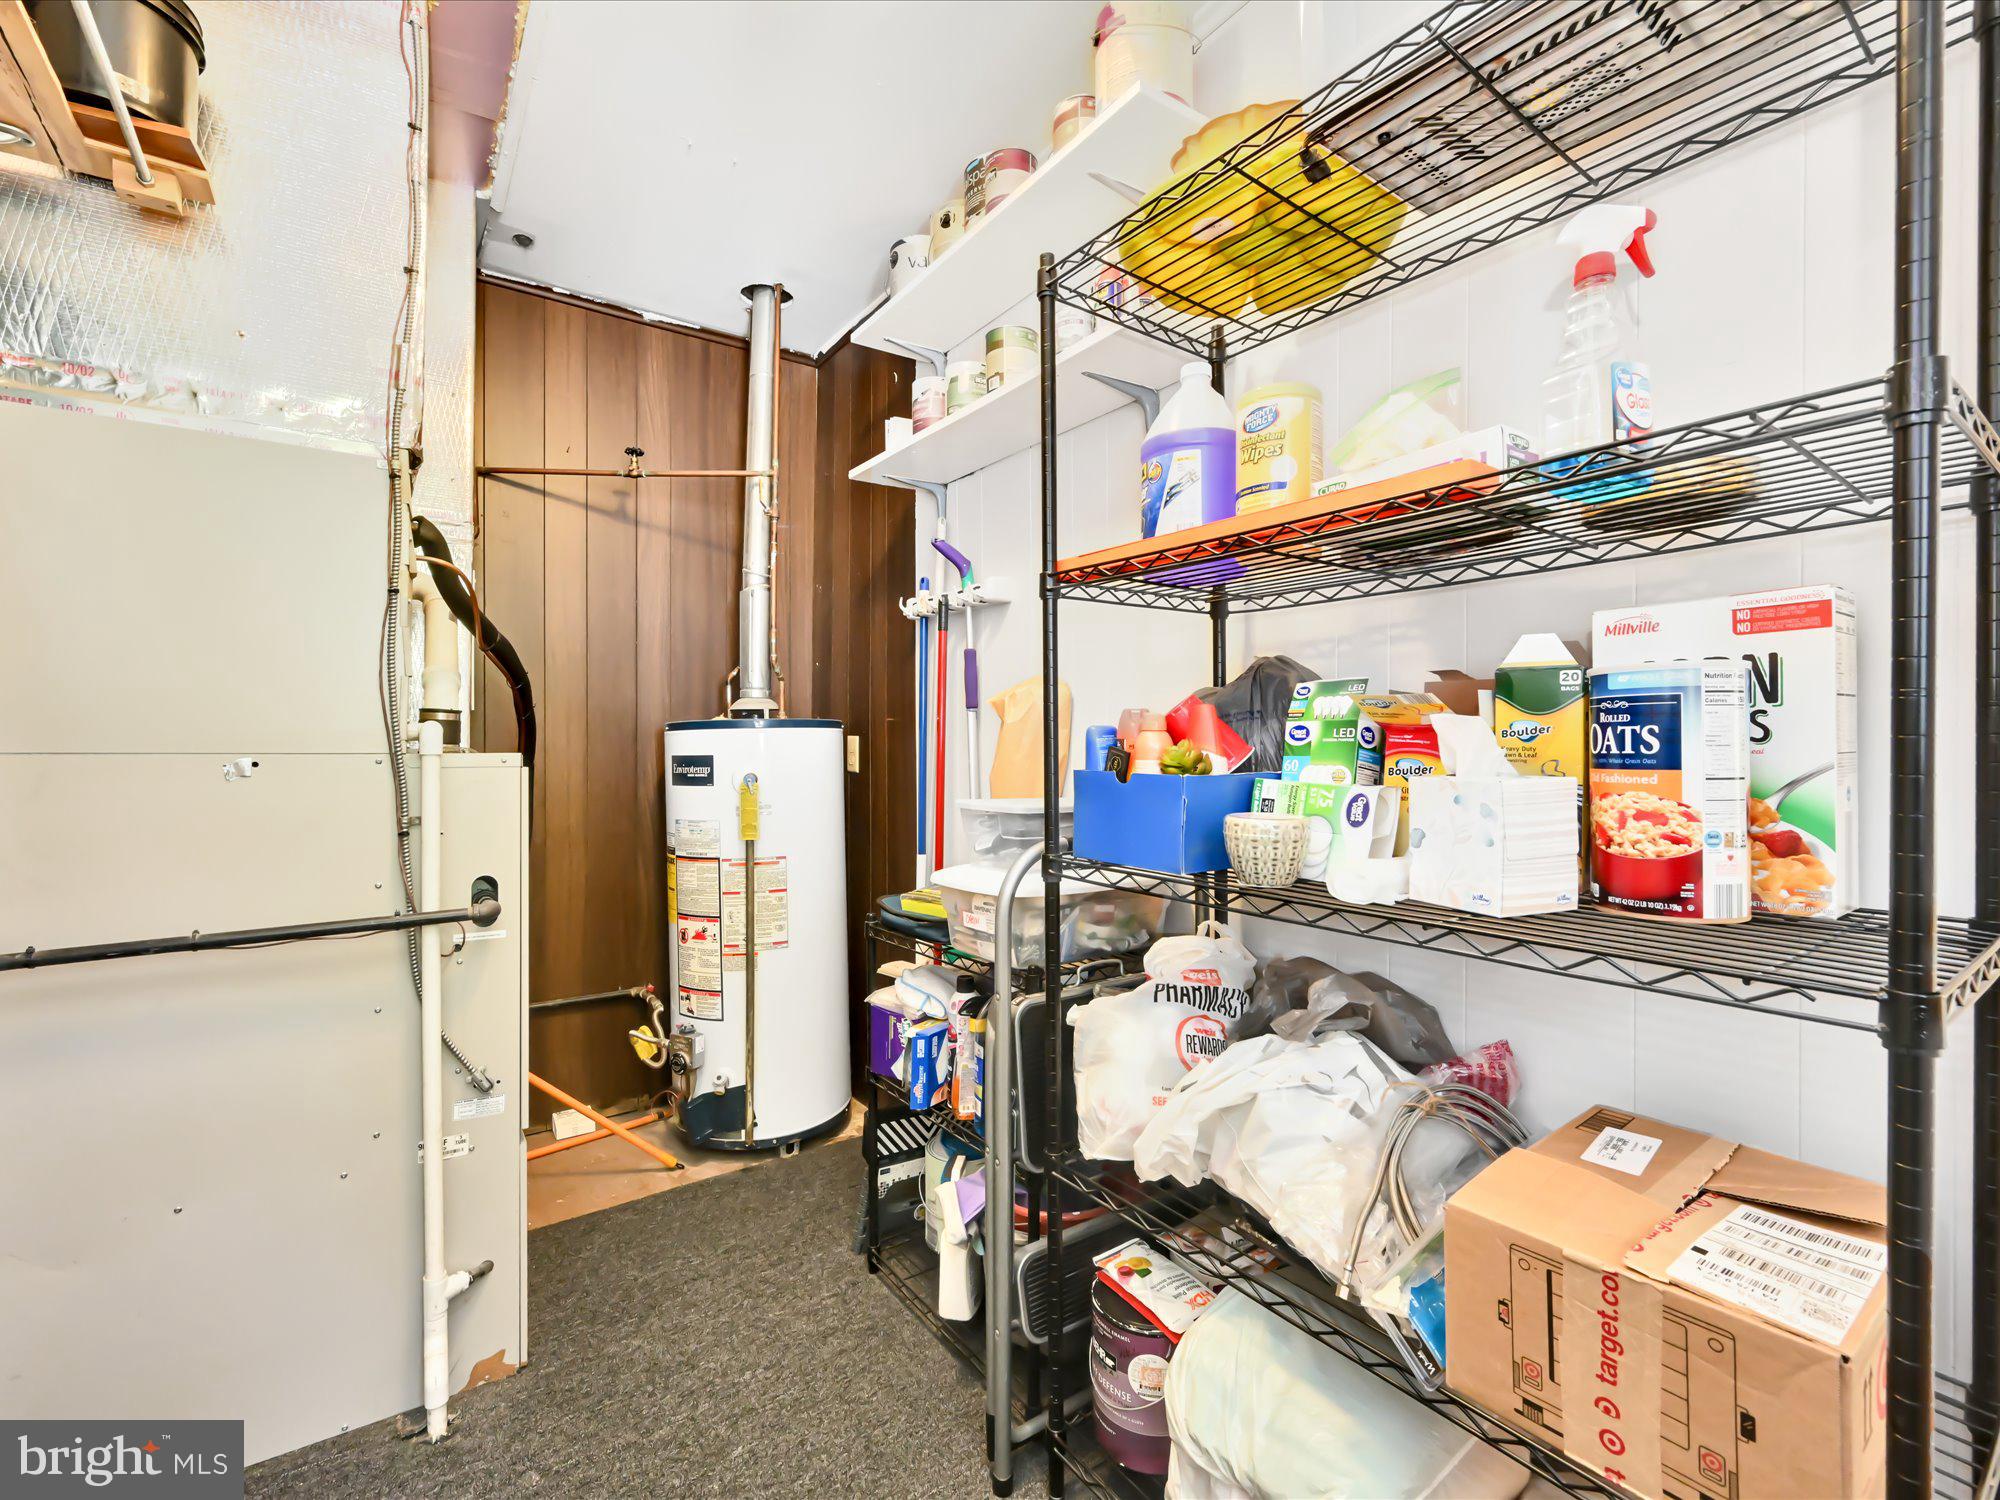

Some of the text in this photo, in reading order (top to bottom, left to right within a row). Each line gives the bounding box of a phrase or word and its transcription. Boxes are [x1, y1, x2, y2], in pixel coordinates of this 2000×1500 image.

[1245, 413, 1274, 432] FORCE
[1240, 444, 1284, 466] Wipes
[1736, 592, 1822, 607] ESSENTIAL GOODNESS
[1736, 609, 1751, 621] NO
[1604, 620, 1661, 637] Millville
[1736, 621, 1751, 633] NO
[1562, 672, 1580, 682] 20
[1348, 683, 1366, 692] LED
[1600, 712, 1631, 723] ROLLED
[1333, 727, 1356, 738] LED
[1502, 725, 1551, 739] Boulder
[1590, 723, 1661, 755] OATS
[673, 764, 711, 776] Envirotemp
[1283, 759, 1299, 772] 60
[1387, 765, 1434, 777] Boulder
[1600, 773, 1659, 785] Fashioned
[1319, 788, 1335, 809] 75
[1355, 796, 1367, 822] Great
[1640, 900, 1647, 908] LB
[1154, 983, 1248, 1019] PHARMACY
[1185, 1290, 1216, 1310] HDX
[1098, 1373, 1133, 1403] DEFENSE
